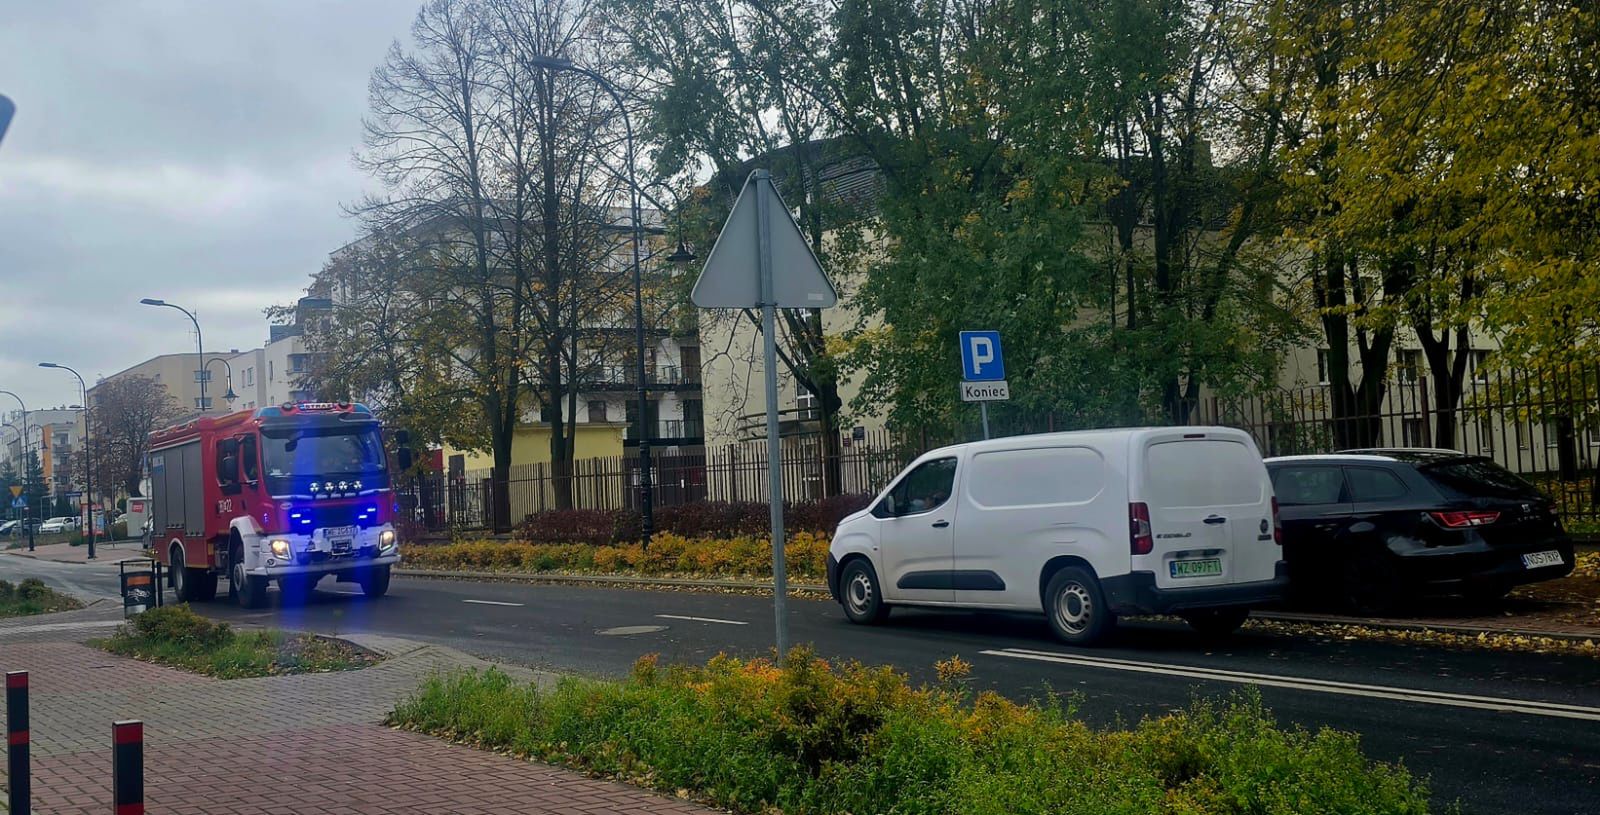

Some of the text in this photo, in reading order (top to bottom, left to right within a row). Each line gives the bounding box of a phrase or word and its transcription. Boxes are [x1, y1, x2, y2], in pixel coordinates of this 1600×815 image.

[970, 337, 994, 375] P
[965, 385, 1006, 398] Koniec
[1177, 560, 1219, 574] WZ 097FT
